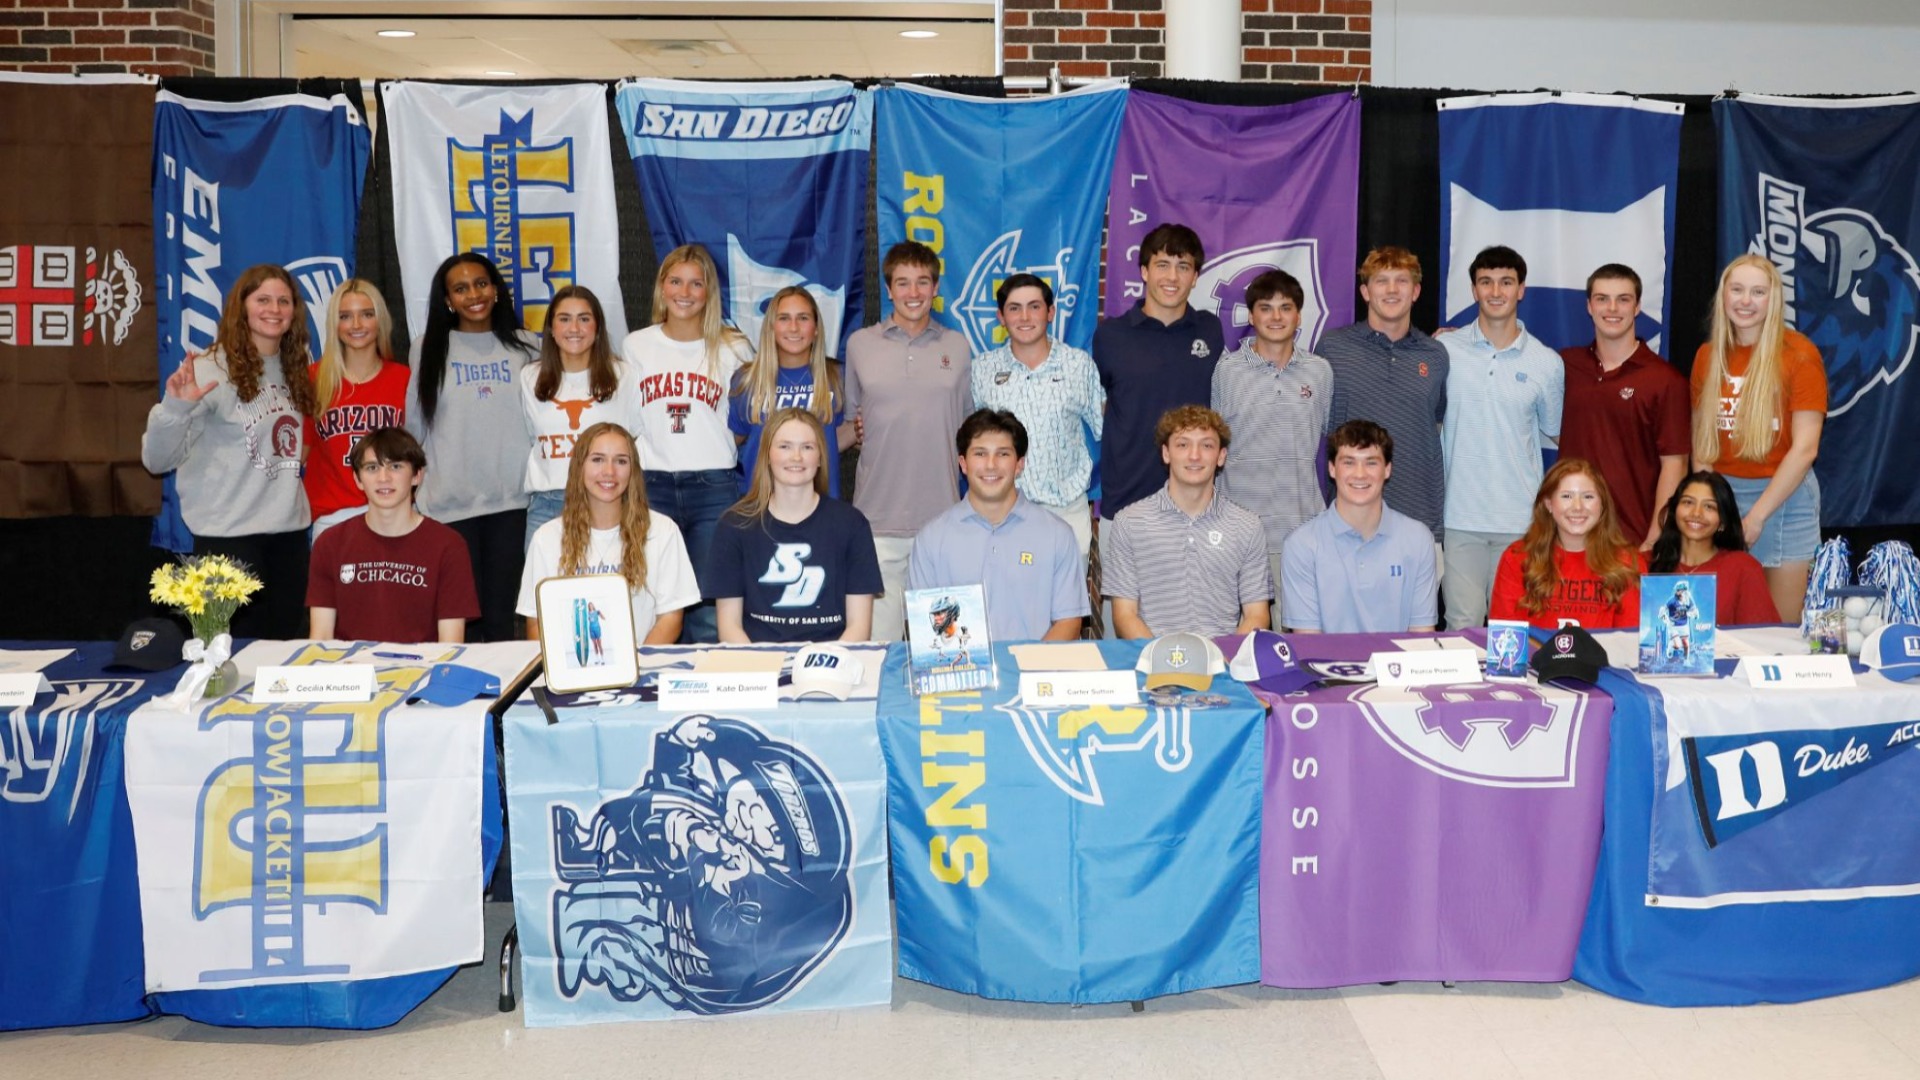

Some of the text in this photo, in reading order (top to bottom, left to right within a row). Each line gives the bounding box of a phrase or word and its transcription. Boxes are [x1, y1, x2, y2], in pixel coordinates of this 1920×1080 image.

[638, 102, 854, 139] SAN DIEGO
[180, 166, 224, 356] EMO
[451, 359, 512, 386] TIGERS
[639, 371, 724, 412] TEXAS TECH
[774, 384, 815, 394] OLLINS
[537, 433, 579, 460] TEX
[358, 561, 427, 573] THE UNIVERSITY OF
[1020, 552, 1034, 566] R
[356, 569, 425, 587] CHICAGO
[757, 542, 826, 607] SD
[788, 617, 800, 625] OF
[801, 617, 818, 625] SAN
[820, 614, 842, 623] DIEGO
[804, 653, 840, 669] USD
[296, 683, 361, 692] Cecilia Knutson
[716, 683, 768, 693] Kate Danner
[921, 669, 987, 694] COMMITTED
[1794, 736, 1870, 778] Duke
[1705, 740, 1787, 821] D
